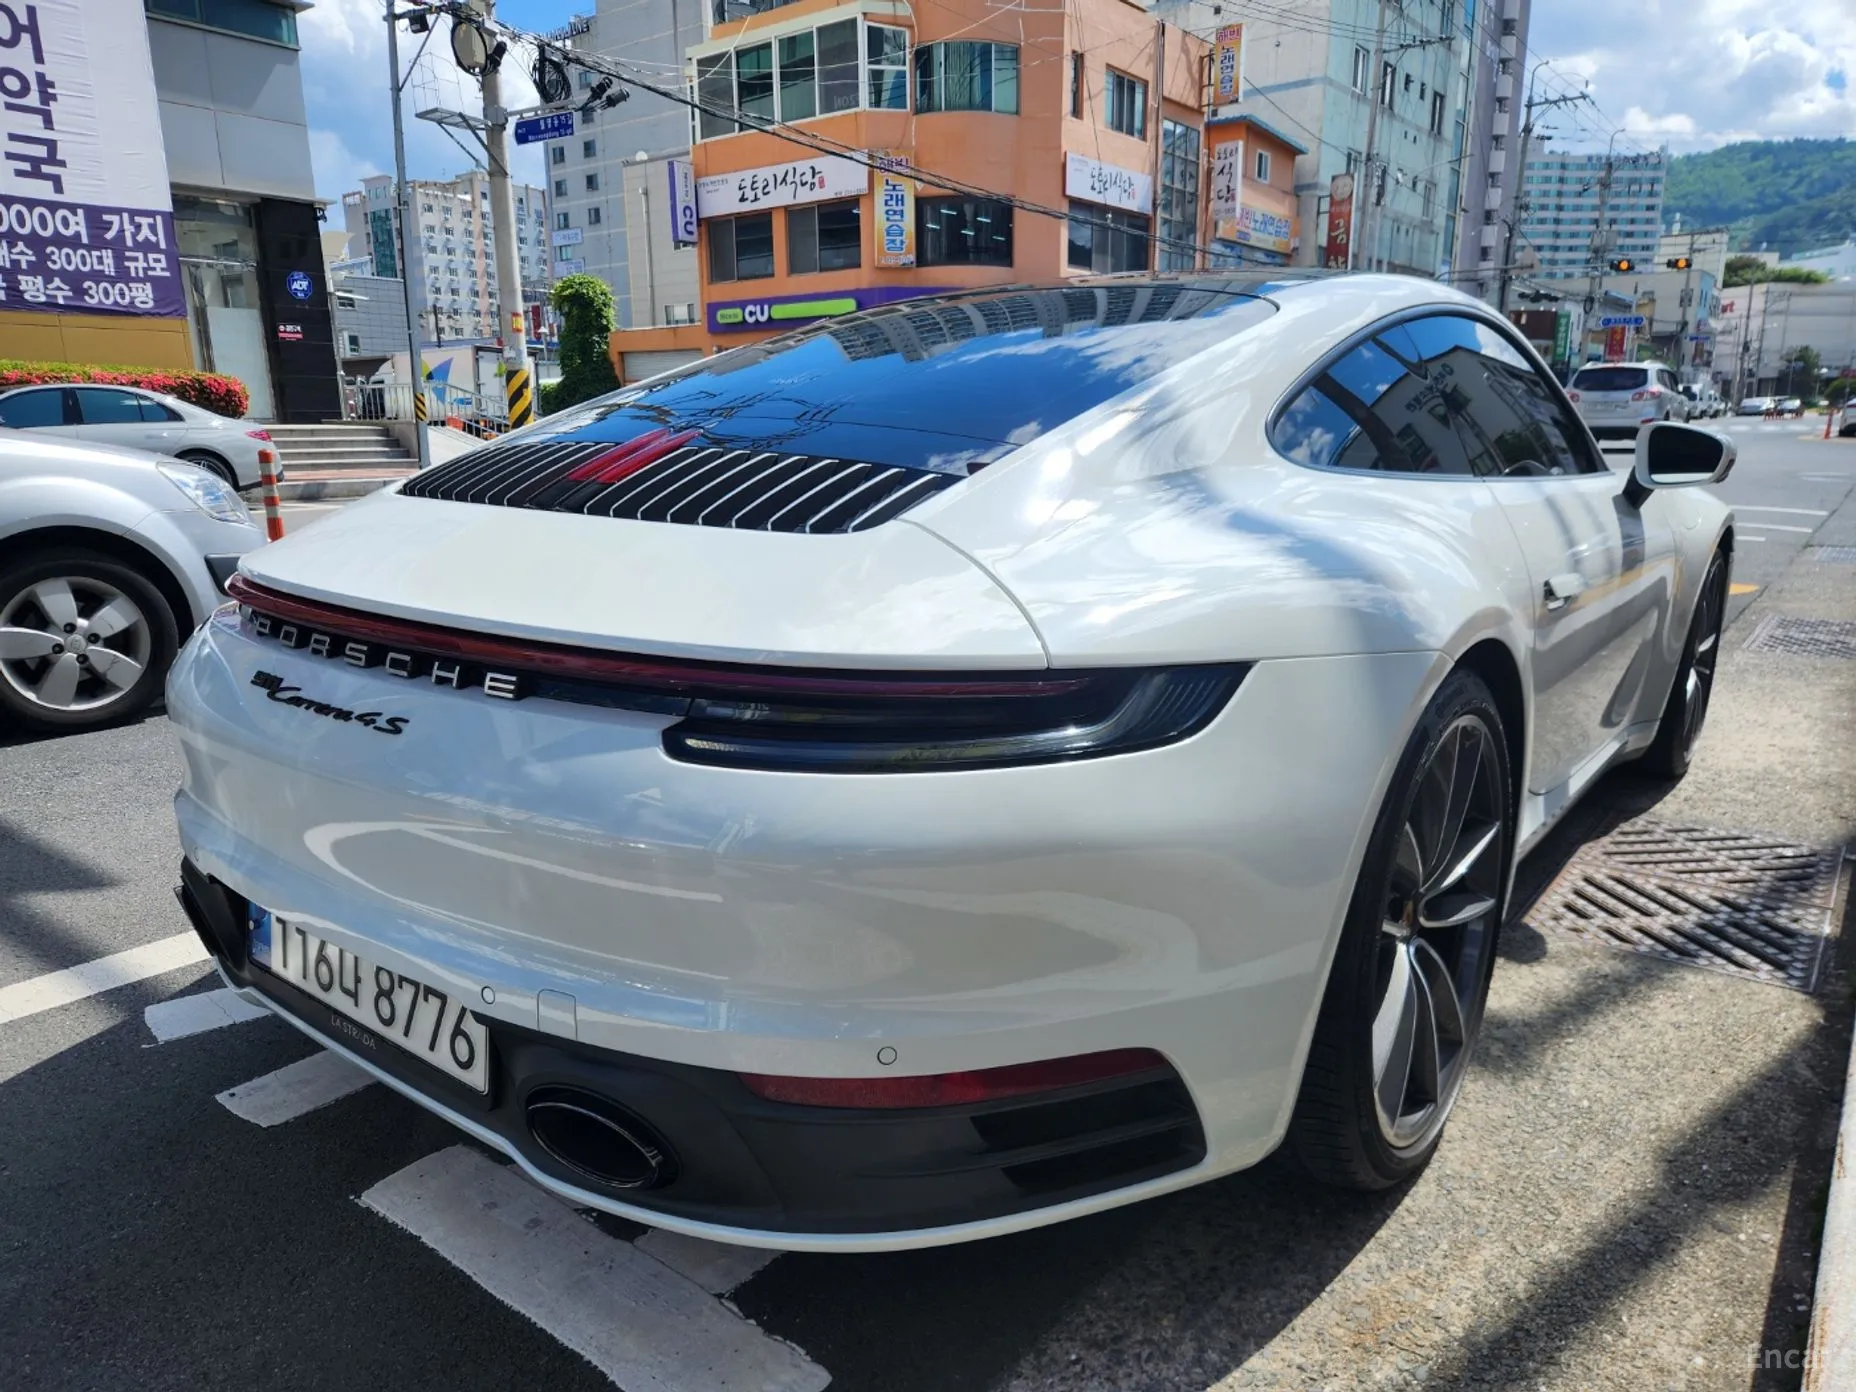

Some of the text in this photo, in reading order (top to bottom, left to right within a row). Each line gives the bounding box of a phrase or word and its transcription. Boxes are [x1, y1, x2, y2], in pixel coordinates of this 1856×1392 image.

[738, 165, 823, 203] 도토리식당
[1090, 166, 1134, 204] 도토리식당
[102, 212, 167, 249] 가지
[683, 205, 695, 236] CU
[884, 178, 906, 254] 노래연습장
[45, 246, 115, 276] 300대
[124, 251, 171, 278] 규모
[18, 274, 73, 304] 평수
[83, 280, 154, 309] 300평
[292, 280, 309, 291] ADT
[745, 305, 769, 323] CU
[254, 617, 518, 699] PORSCHE
[275, 915, 476, 1071] 116나 8776
